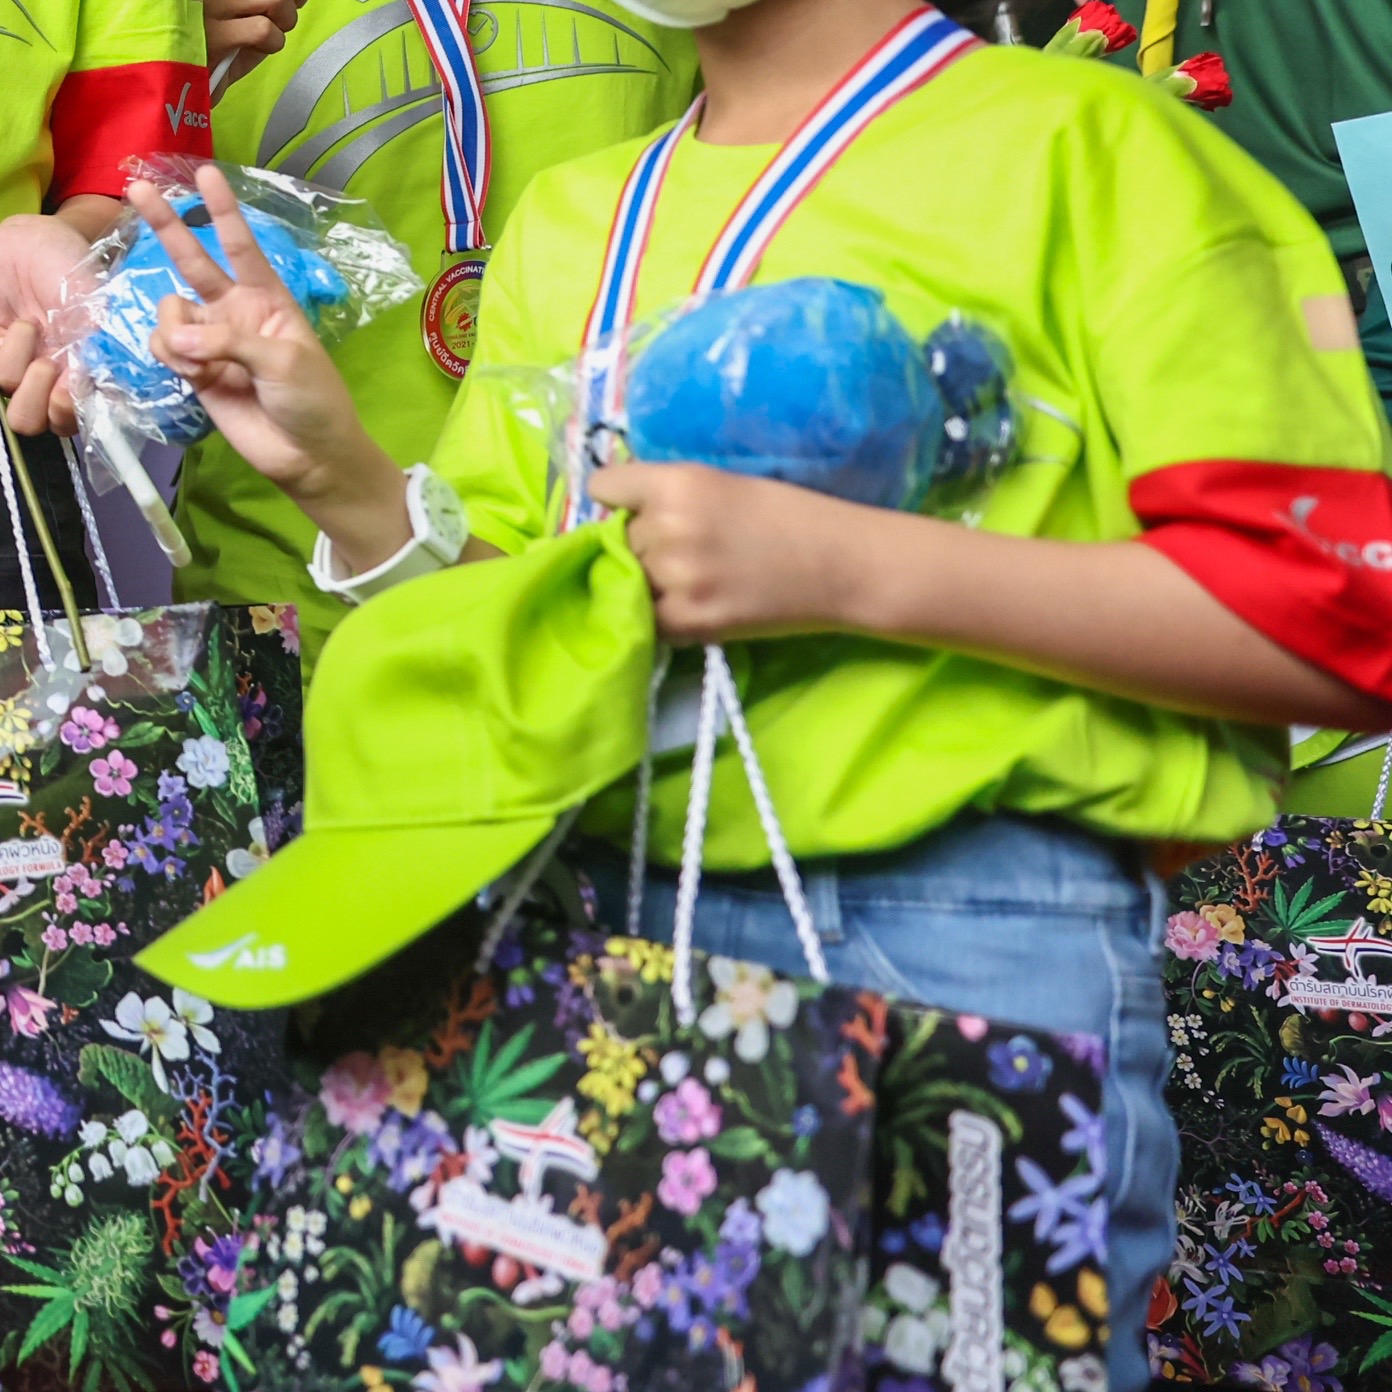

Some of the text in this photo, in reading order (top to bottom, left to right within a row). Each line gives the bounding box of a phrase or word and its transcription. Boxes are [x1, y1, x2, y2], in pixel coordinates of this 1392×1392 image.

[429, 283, 447, 322] CENTRAL
[22, 861, 62, 873] FORMULA
[234, 943, 288, 970] AIS
[1291, 996, 1392, 1012] INSTITUTE OF DERMATOLOG
